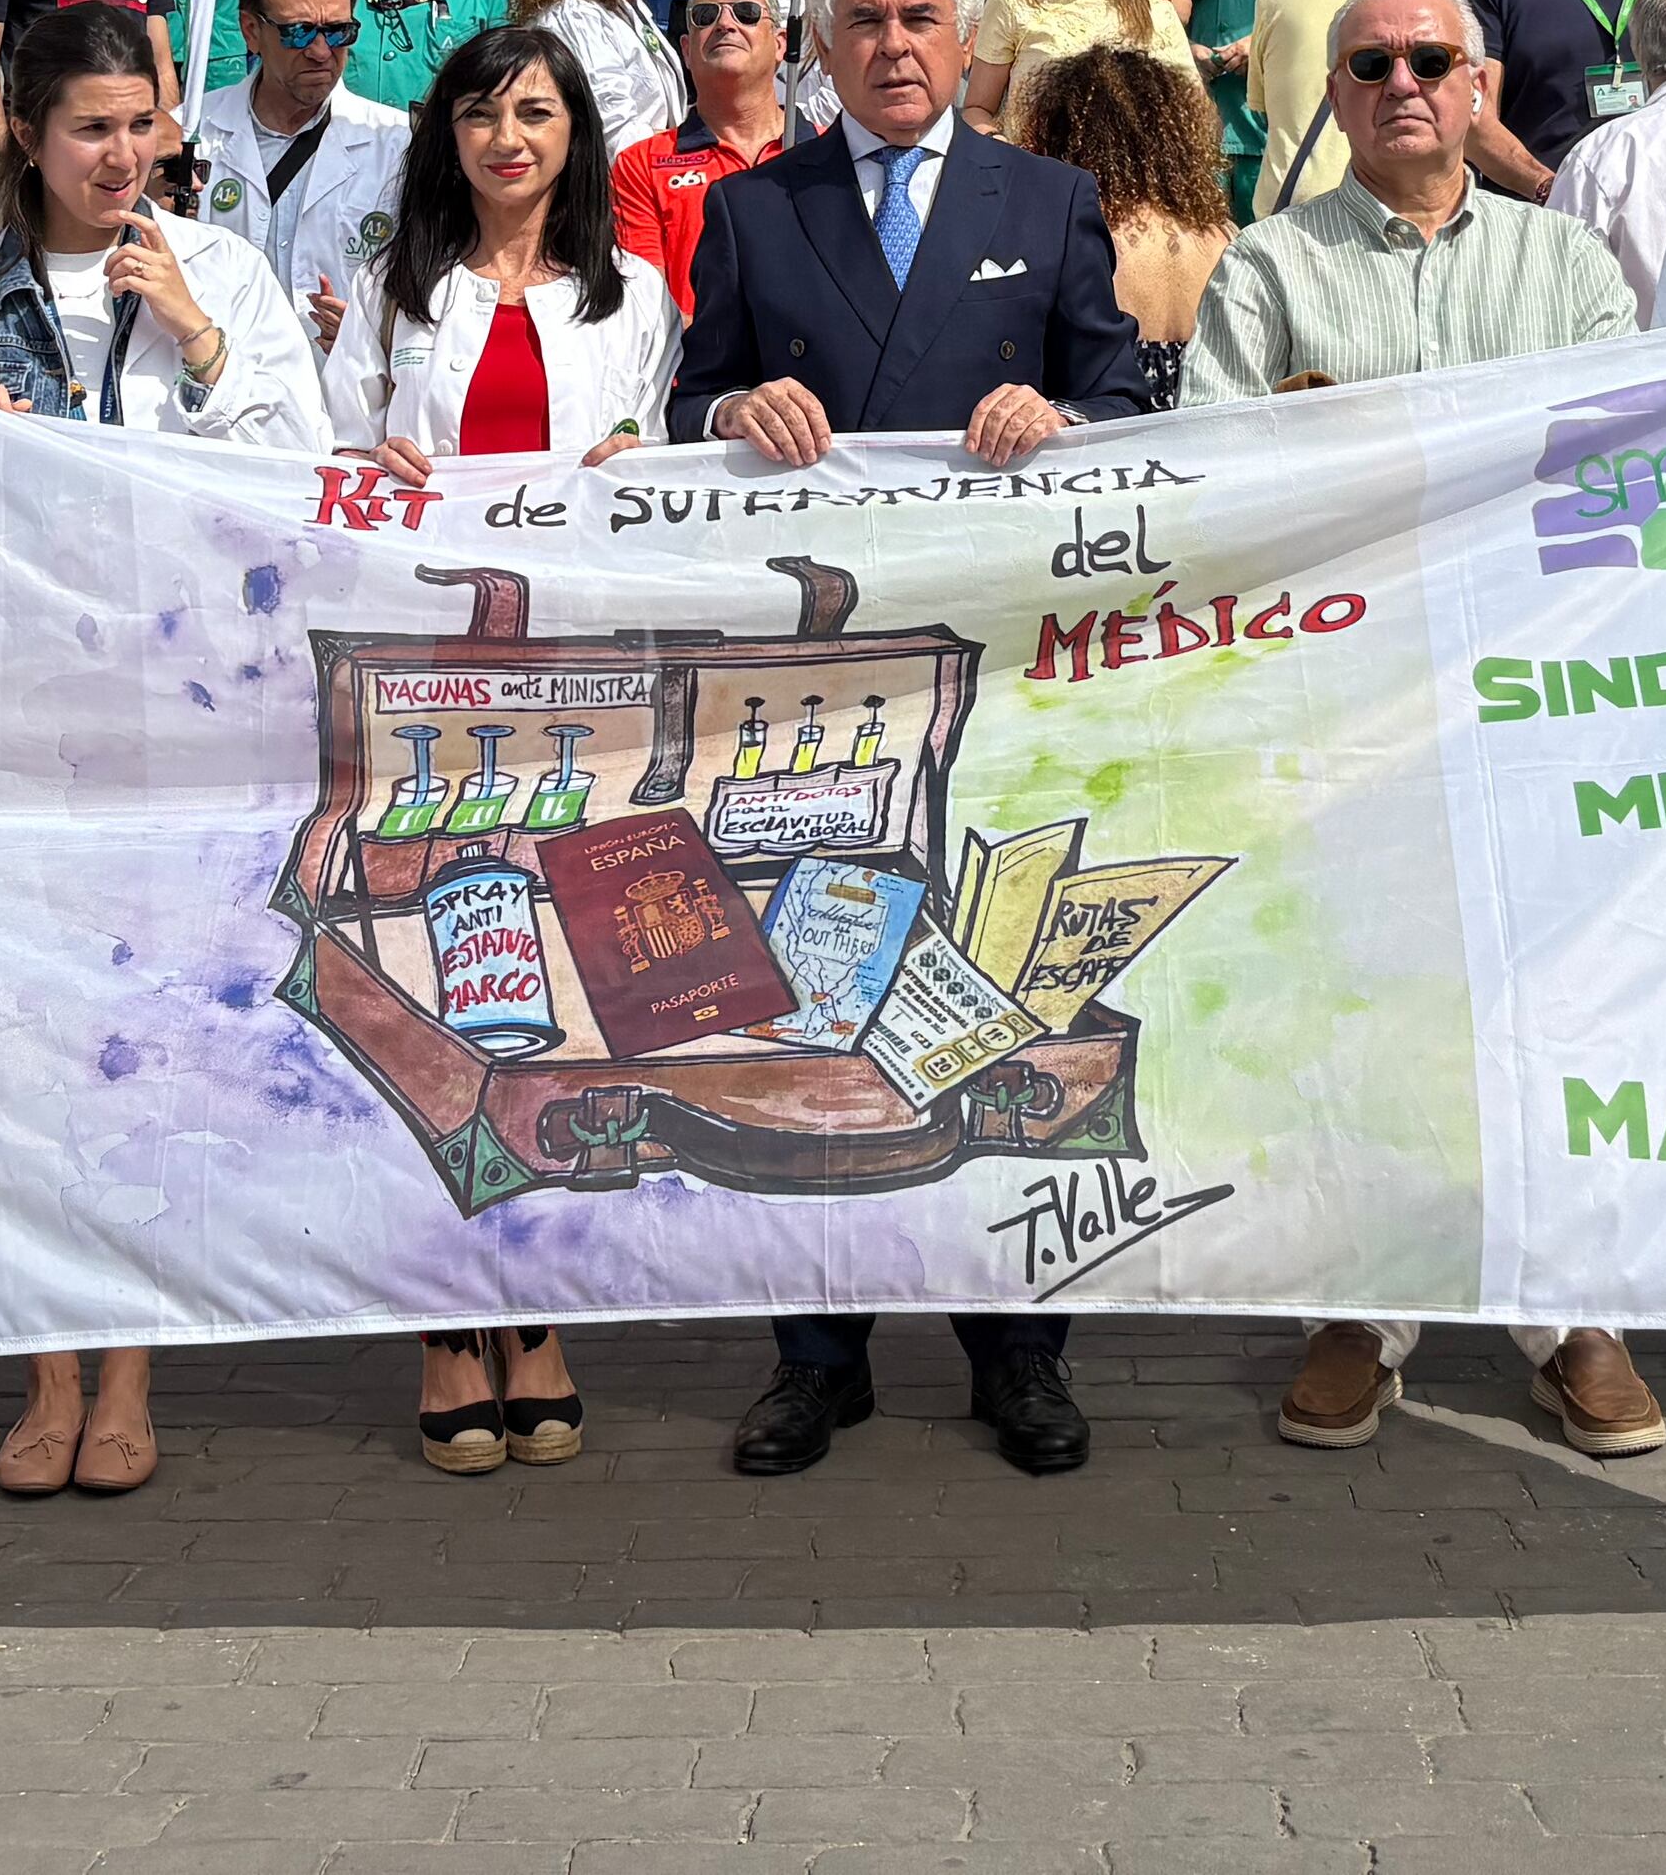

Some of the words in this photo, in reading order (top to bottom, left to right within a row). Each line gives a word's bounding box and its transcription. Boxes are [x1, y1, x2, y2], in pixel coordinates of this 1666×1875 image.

[485, 485, 566, 528] de
[1051, 504, 1171, 579] del
[1025, 583, 1368, 682] MÉDICO
[379, 678, 491, 706] VACUNAS
[501, 675, 543, 699] anti
[545, 675, 650, 704] MINISTRA
[722, 812, 855, 835] ESCLAVITUD
[725, 806, 790, 822] para
[778, 820, 873, 842] LABORAL
[590, 835, 685, 871] ESPAÑA
[430, 882, 527, 920] SPRAY
[452, 907, 502, 937] ANTI
[1043, 896, 1158, 941] RUTAS
[803, 928, 831, 945] OUT
[1080, 931, 1132, 954] DE
[651, 974, 739, 1014] PASAPORTE
